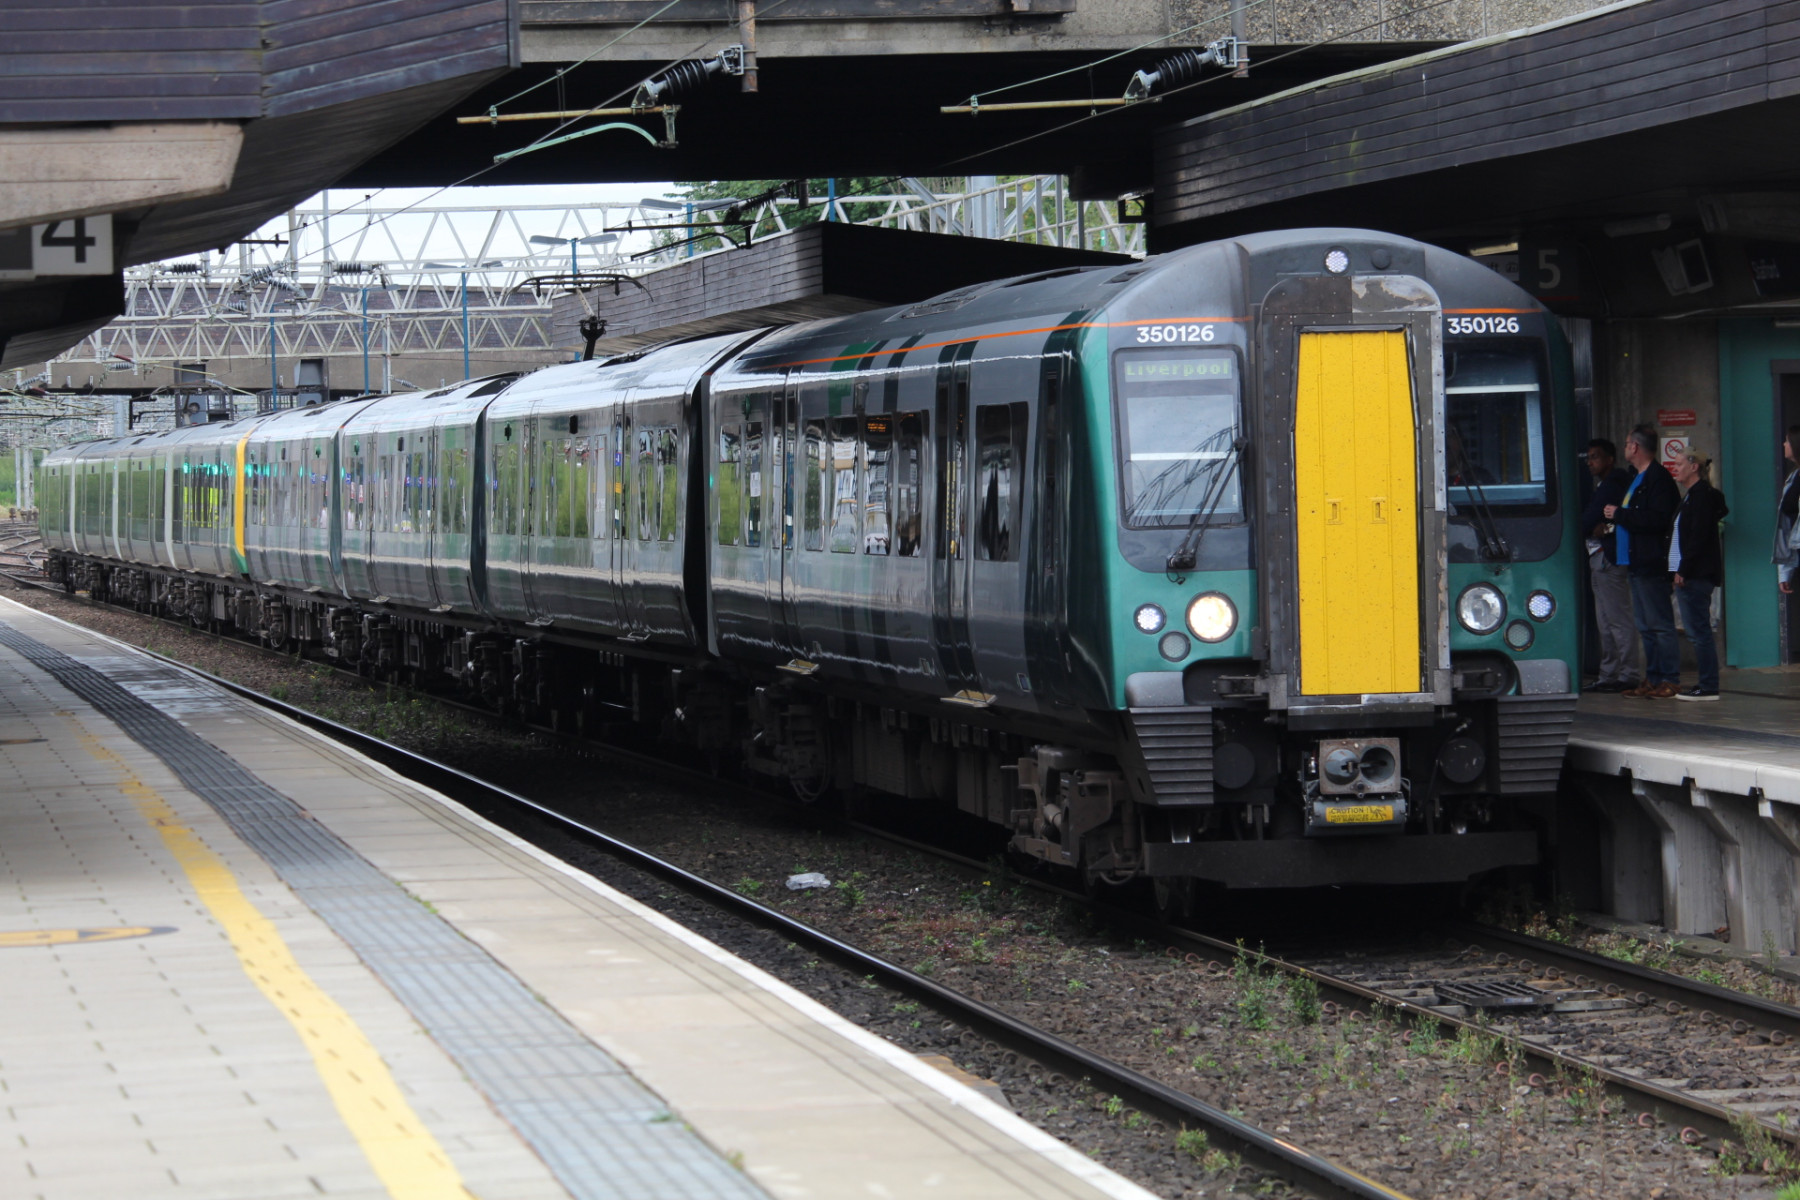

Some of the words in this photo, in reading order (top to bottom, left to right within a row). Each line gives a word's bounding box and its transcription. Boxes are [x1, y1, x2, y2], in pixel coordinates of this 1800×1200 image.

[41, 217, 96, 263] 4
[1538, 249, 1560, 289] 5
[1136, 325, 1214, 343] 350126
[1446, 316, 1519, 334] 350126
[1126, 361, 1230, 377] Liverpool
